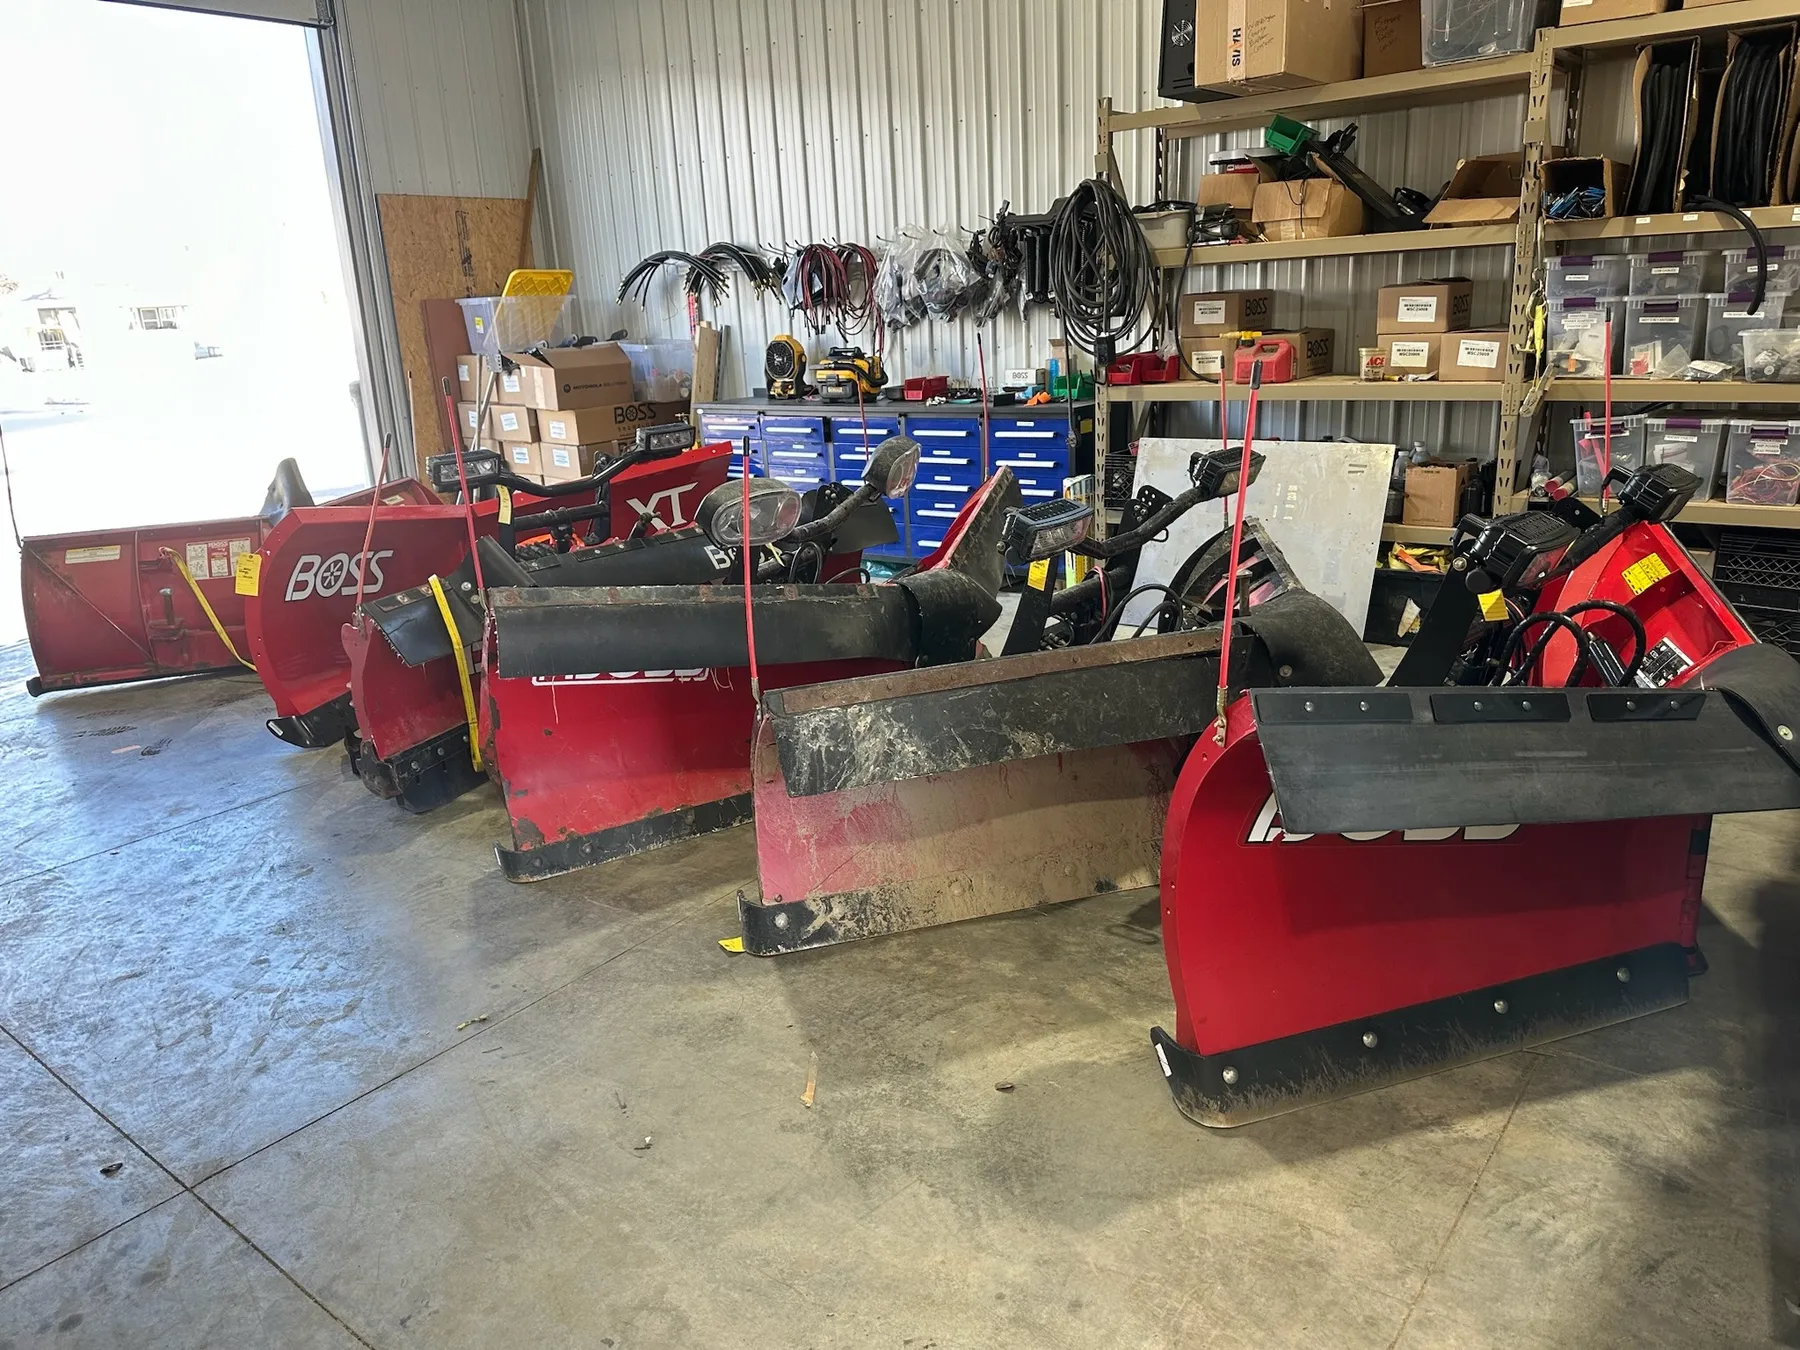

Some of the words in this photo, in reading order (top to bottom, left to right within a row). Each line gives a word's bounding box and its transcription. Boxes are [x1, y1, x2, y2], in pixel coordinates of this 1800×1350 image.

[1245, 297, 1268, 317] BOSS
[1307, 338, 1329, 359] BOSS
[1012, 371, 1028, 379] BOSS
[614, 402, 656, 424] BOSS
[626, 481, 699, 541] XT
[284, 550, 394, 602] BOSS
